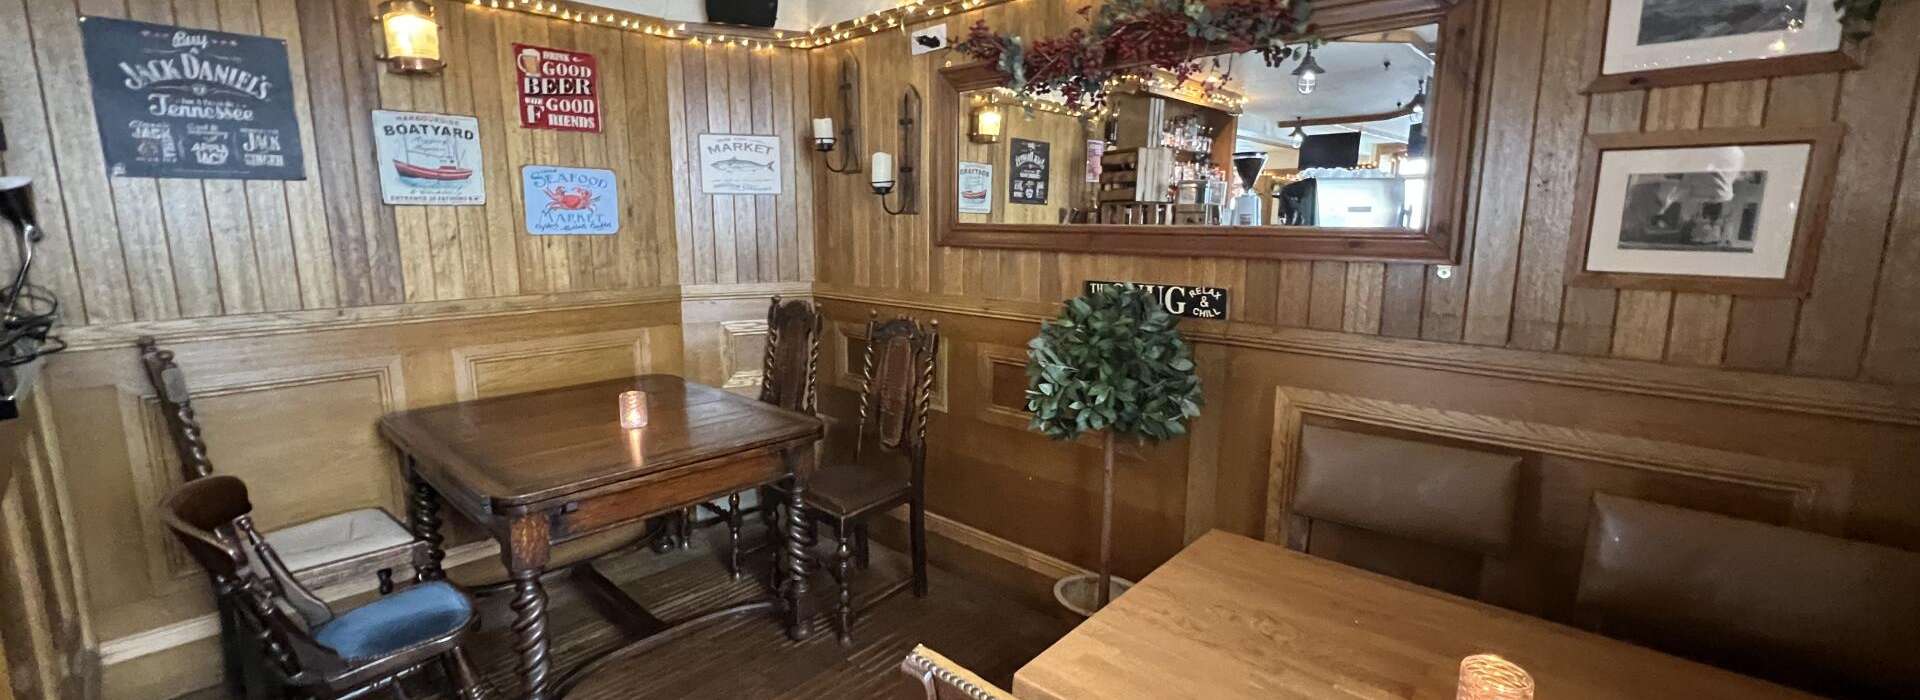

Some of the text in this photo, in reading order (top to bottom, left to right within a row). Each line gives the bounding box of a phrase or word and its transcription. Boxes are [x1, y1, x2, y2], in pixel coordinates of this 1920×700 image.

[172, 31, 208, 48] Buy
[118, 58, 182, 90] JACK
[542, 61, 592, 78] GOOD
[524, 77, 592, 95] BEER
[148, 93, 255, 121] Tennessee
[545, 98, 595, 115] GOOD
[383, 124, 475, 141] BOATYARD
[707, 142, 775, 155] MARKET
[530, 171, 608, 189] SEAFOOD
[539, 207, 605, 223] MARKET
[1188, 286, 1222, 300] RELAX
[1200, 295, 1210, 307] &
[1192, 307, 1222, 318] CHILL
